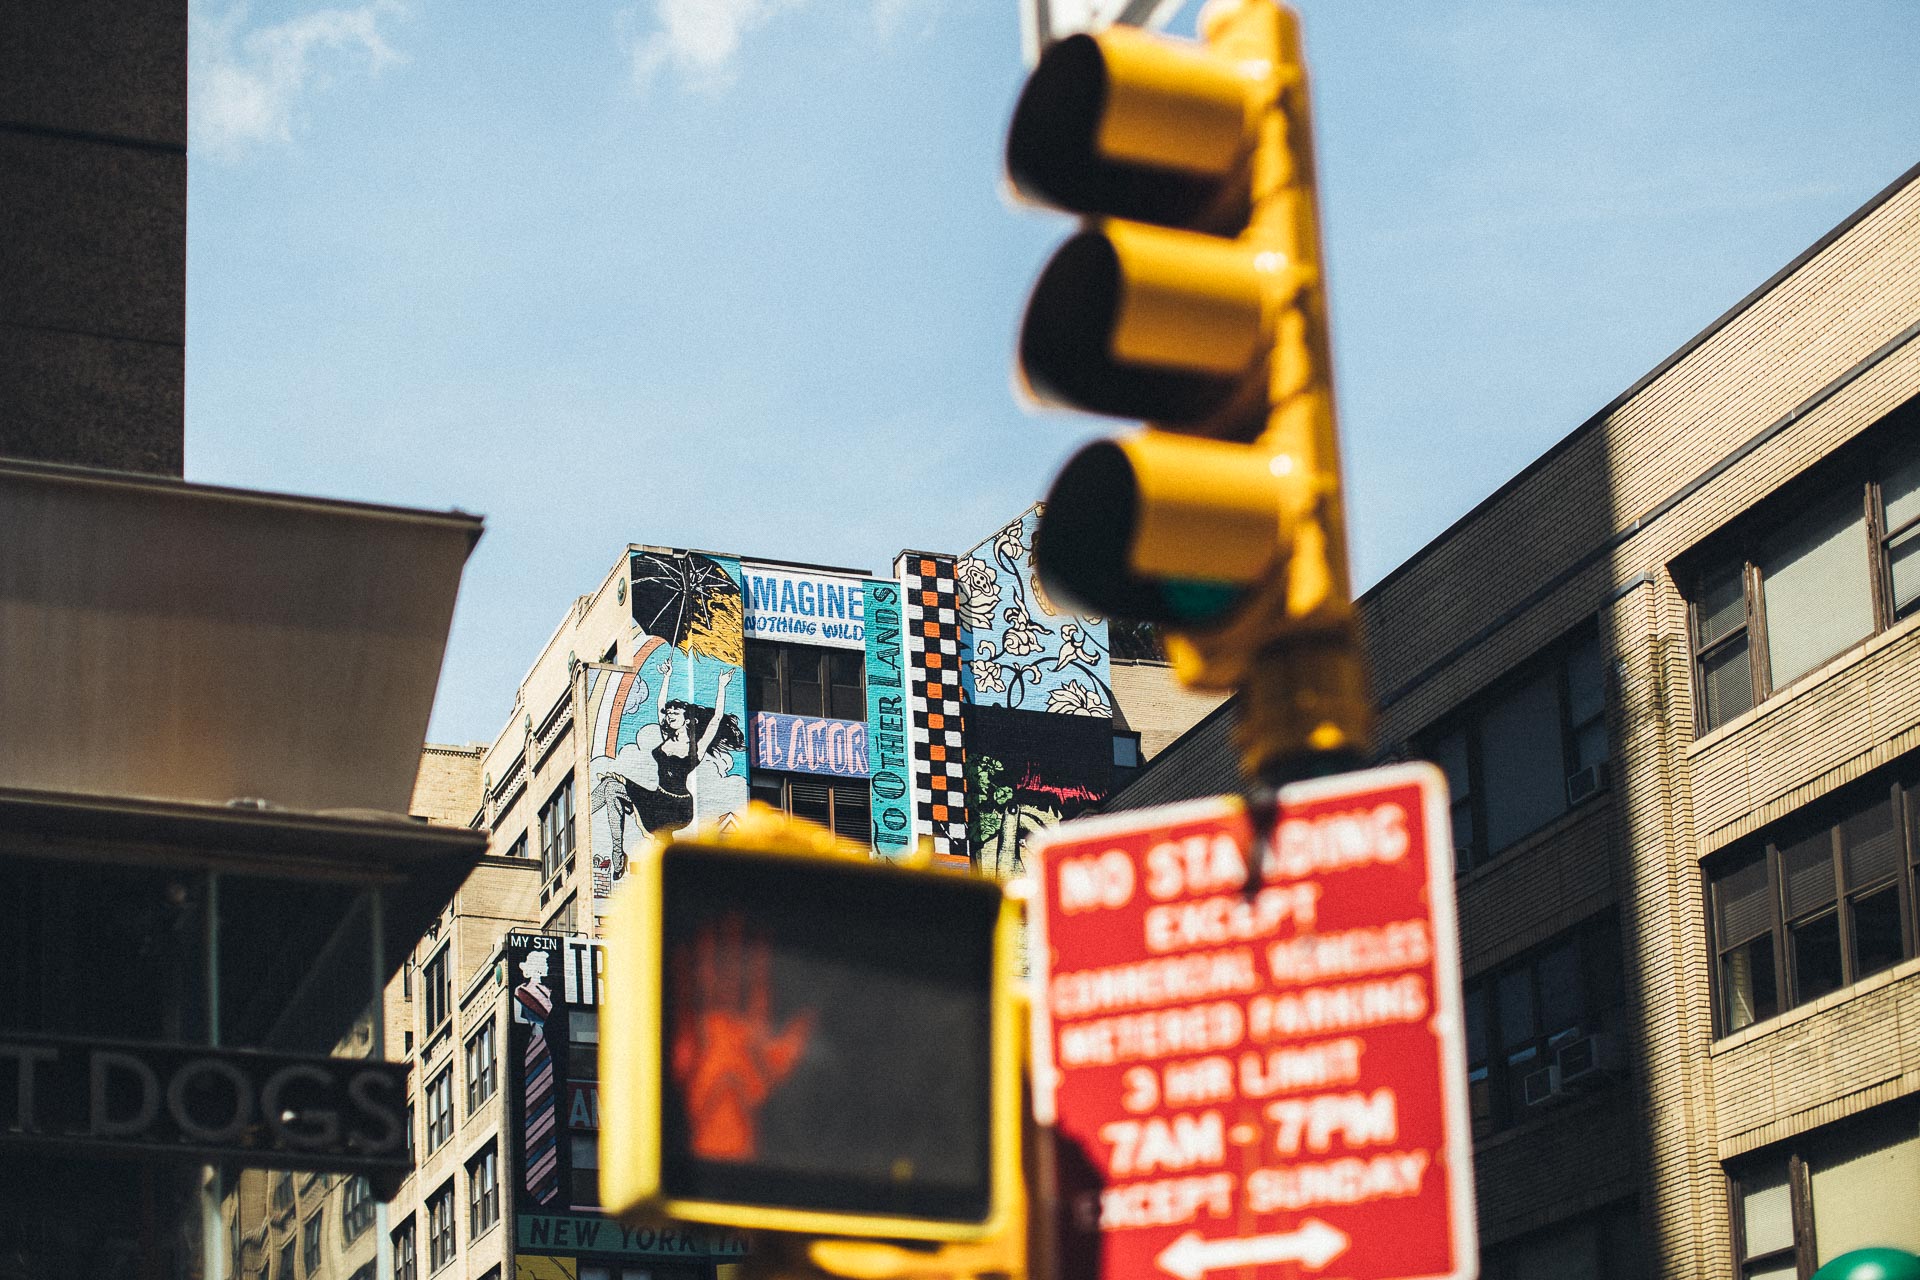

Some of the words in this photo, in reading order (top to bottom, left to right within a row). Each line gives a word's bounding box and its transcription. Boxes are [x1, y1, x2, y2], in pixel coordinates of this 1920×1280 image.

[743, 575, 865, 621] IMAGINE
[744, 615, 816, 635] NOTHING
[822, 622, 865, 641] WILD
[869, 587, 902, 688] LANDS
[750, 711, 783, 768] EL
[787, 718, 869, 774] AMOR
[872, 694, 906, 800] OTHER
[1059, 848, 1136, 914] NO
[511, 935, 529, 948] MY
[533, 937, 557, 951] SIN
[89, 1049, 403, 1152] DOGS
[1122, 1064, 1160, 1113] 3
[1162, 1055, 1235, 1108] HR
[1100, 1109, 1227, 1178] 7AM
[1263, 1086, 1397, 1156] 7PM
[530, 1217, 600, 1247] NEW
[617, 1221, 697, 1253] YORK
